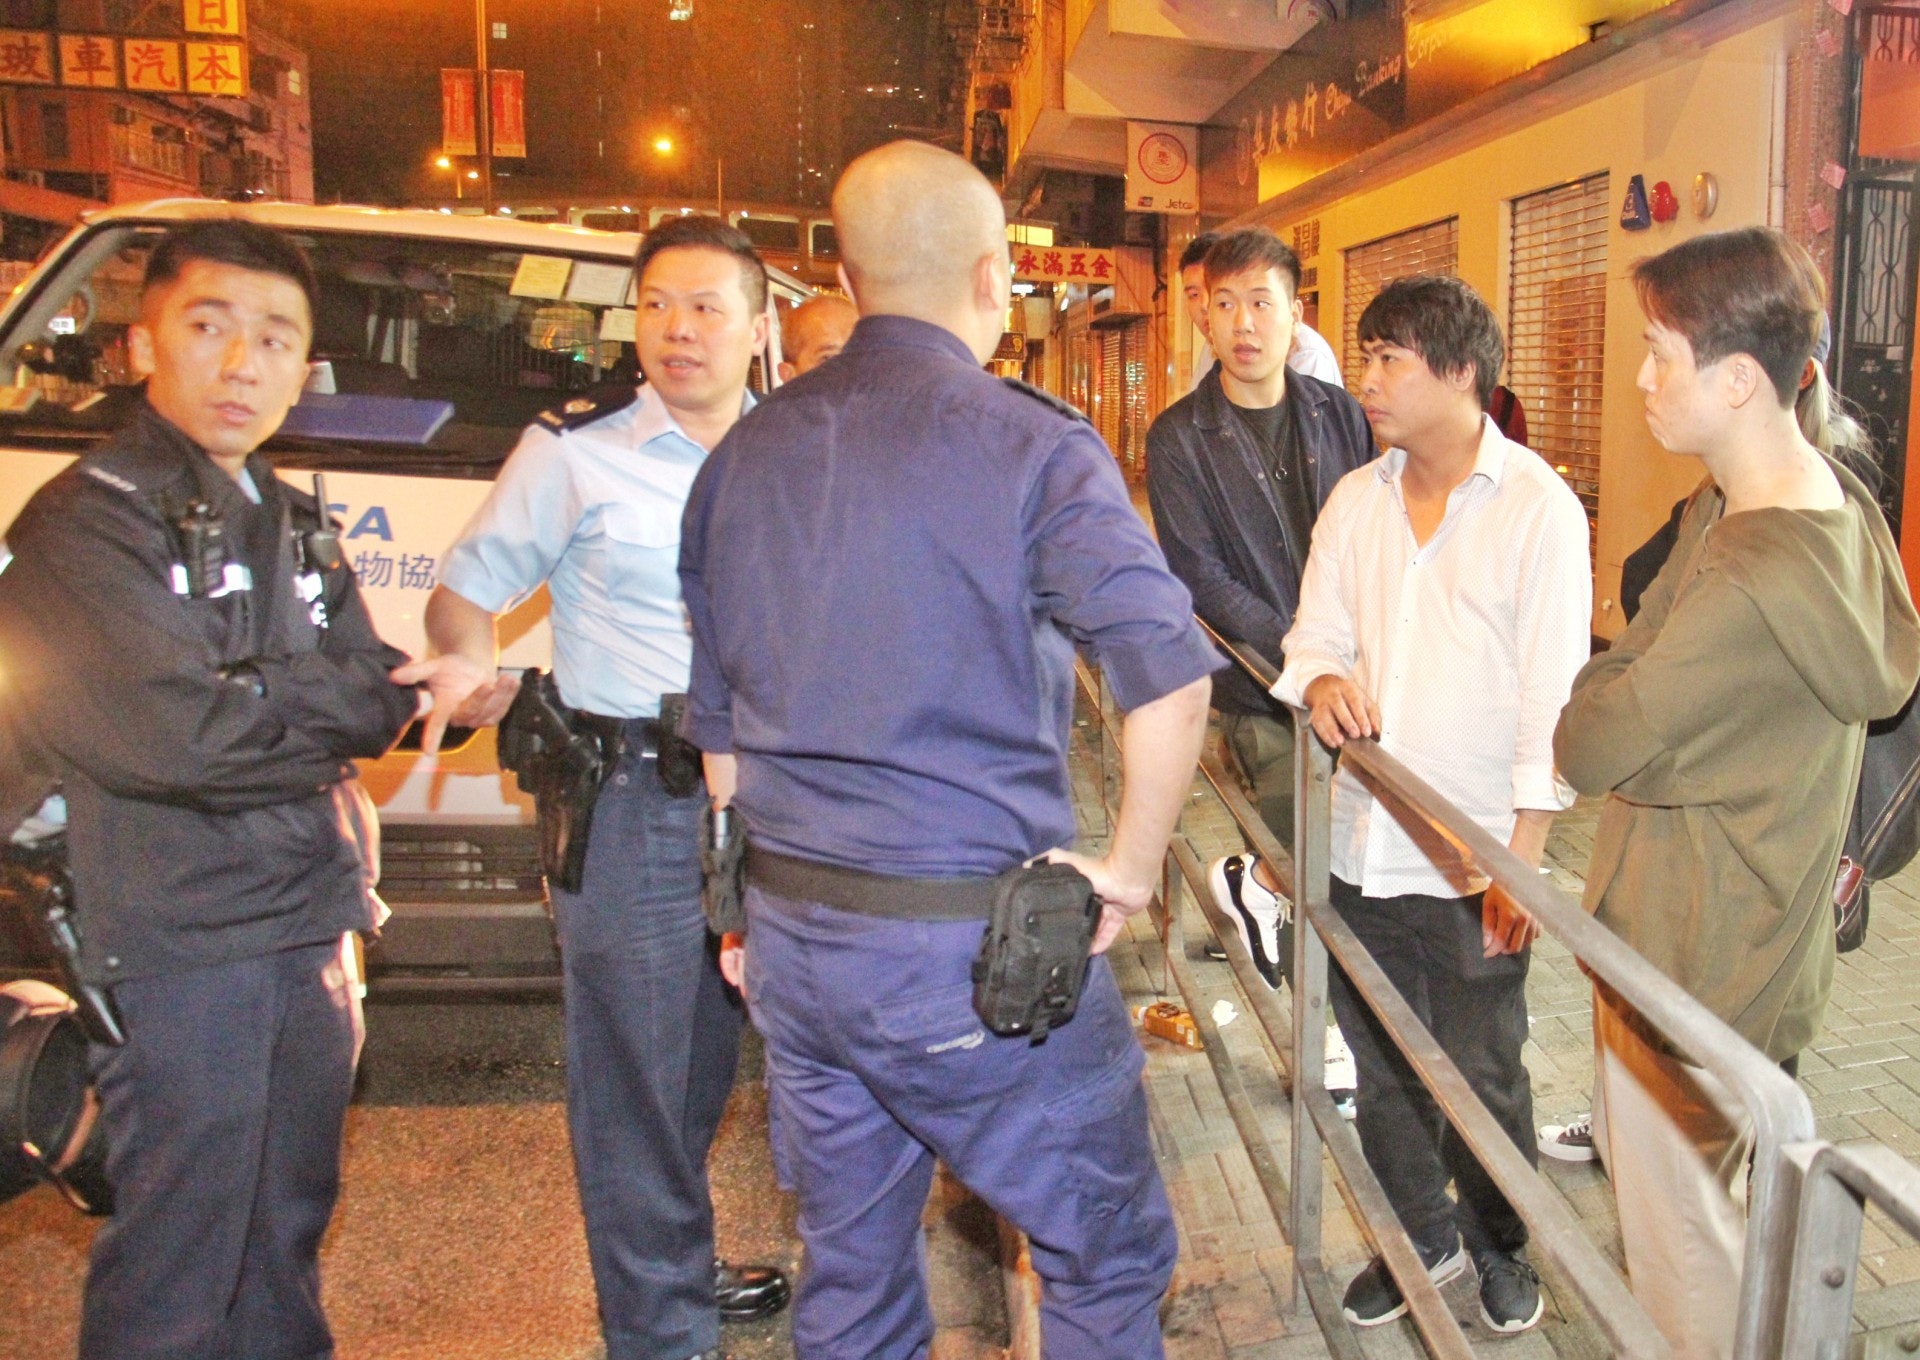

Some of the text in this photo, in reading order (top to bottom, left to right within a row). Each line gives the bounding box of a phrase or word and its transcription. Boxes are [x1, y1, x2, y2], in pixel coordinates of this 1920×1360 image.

[1017, 248, 1114, 278] 永滿五金
[355, 550, 436, 590] 物協
